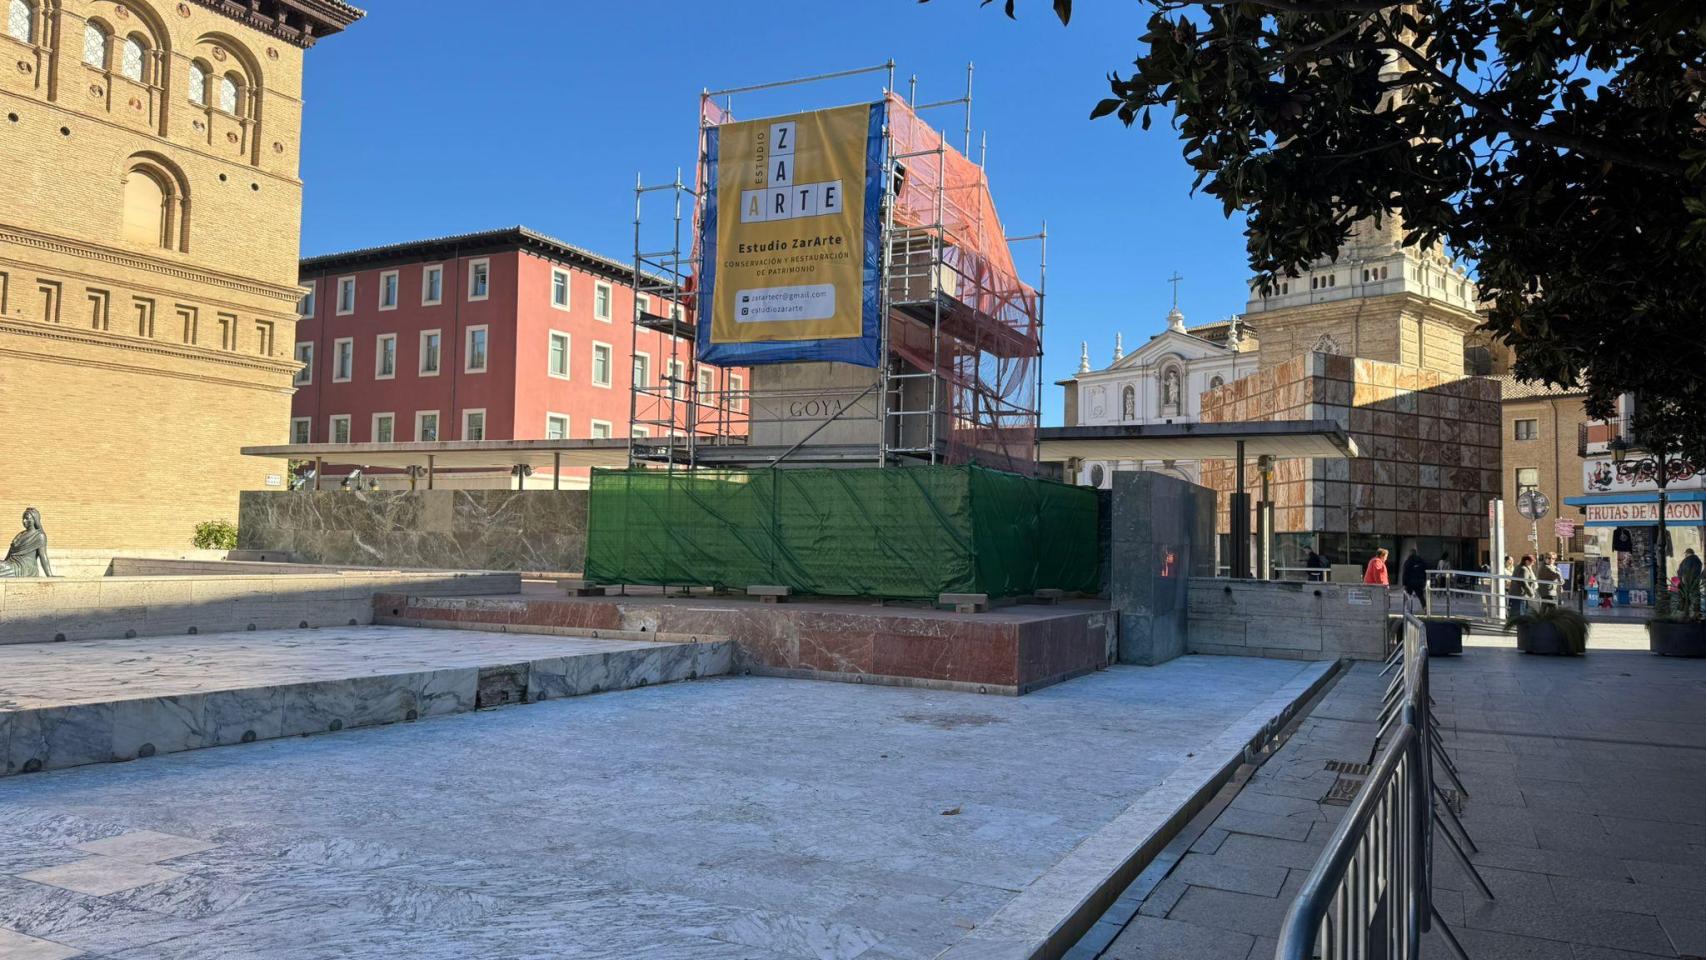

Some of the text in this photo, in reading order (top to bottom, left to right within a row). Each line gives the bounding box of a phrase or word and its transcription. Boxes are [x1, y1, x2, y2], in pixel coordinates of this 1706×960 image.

[755, 132, 765, 185] ESTUDIO
[748, 186, 836, 217] ARTE
[738, 235, 842, 254] Estudio ZarArte
[724, 256, 782, 268] CONSERVACIÓN
[790, 252, 849, 263] RESTAURACIÓN
[768, 265, 815, 275] PATRIMONIO
[790, 399, 844, 417] GOYA
[1588, 504, 1700, 520] FRUTAS DE AAGON
